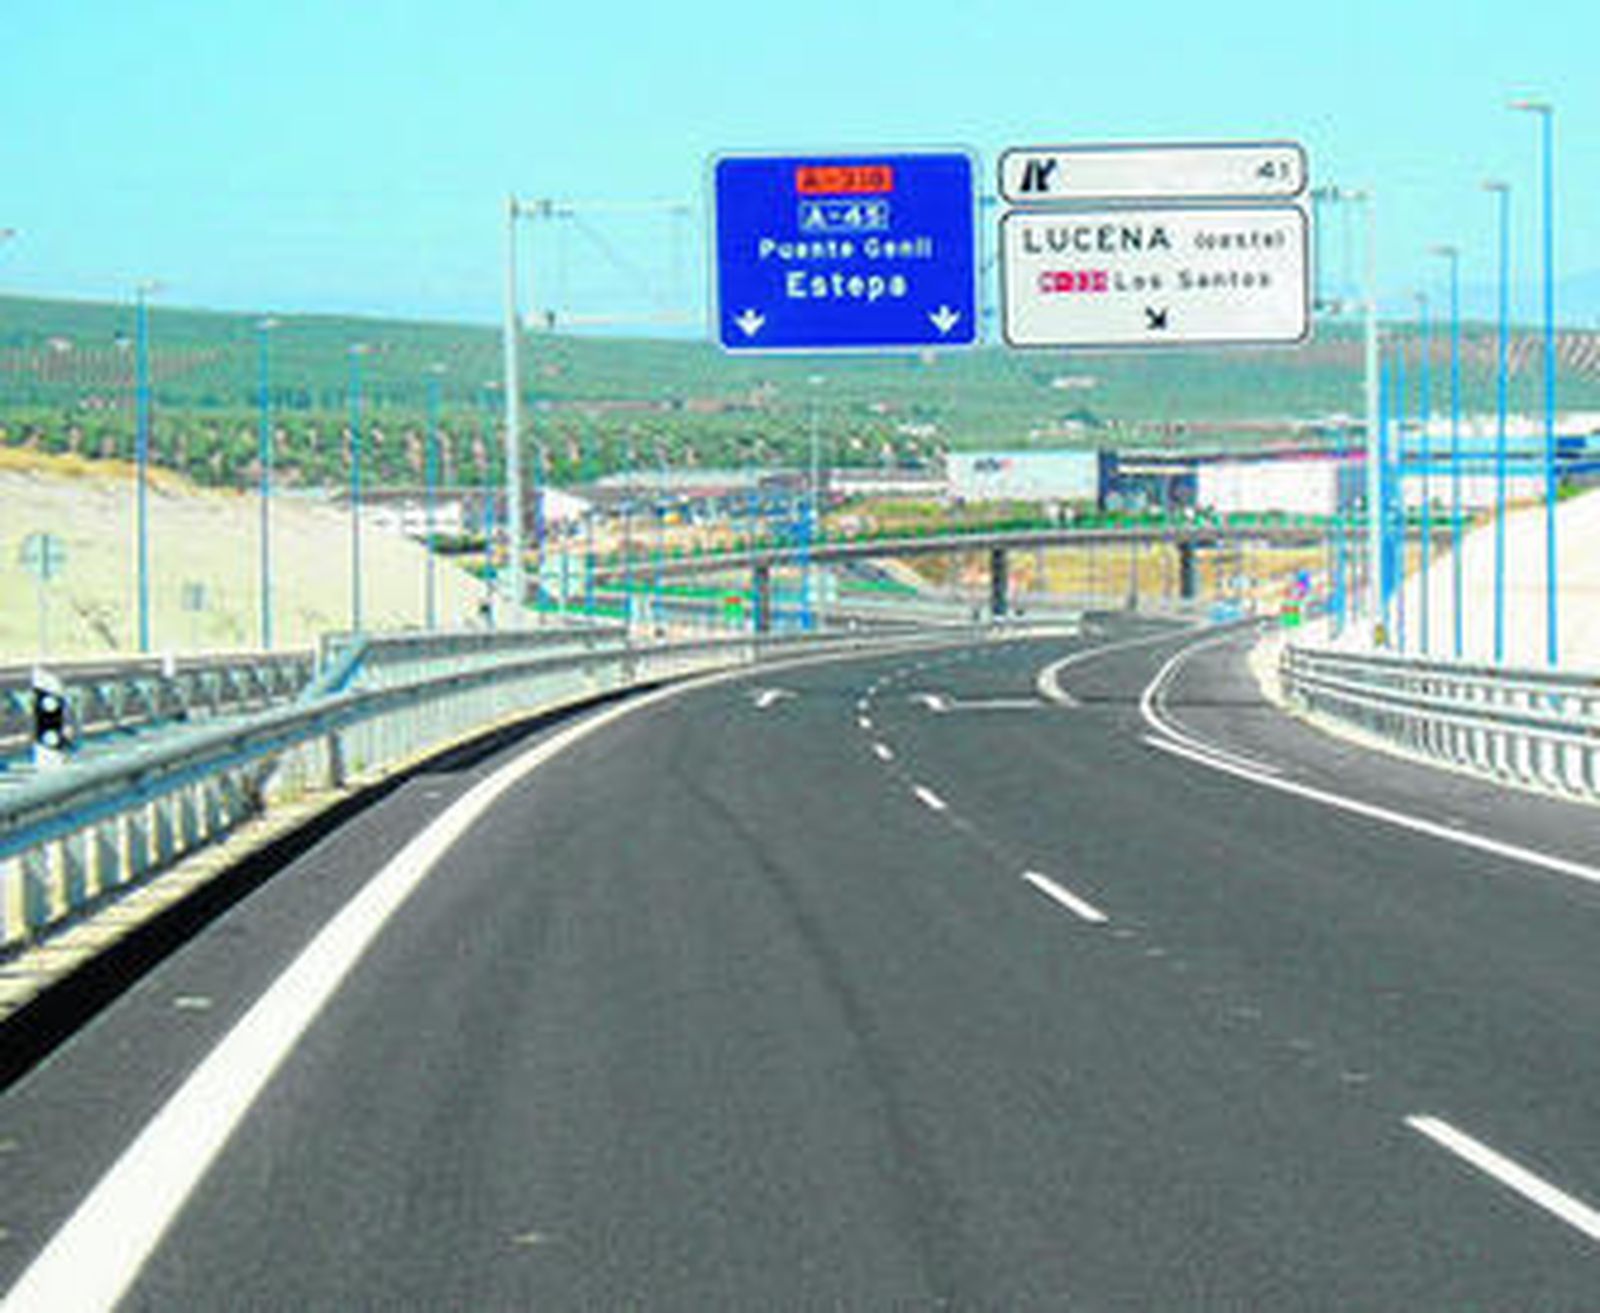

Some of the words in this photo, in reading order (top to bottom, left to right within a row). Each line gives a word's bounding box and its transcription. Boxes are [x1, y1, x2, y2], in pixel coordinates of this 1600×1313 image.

[759, 238, 853, 259] Puente
[863, 238, 932, 259] Genil
[1022, 225, 1171, 252] LUCENA
[786, 271, 907, 301] Estepa
[1114, 271, 1162, 291] Los
[1178, 268, 1270, 289] Santos
